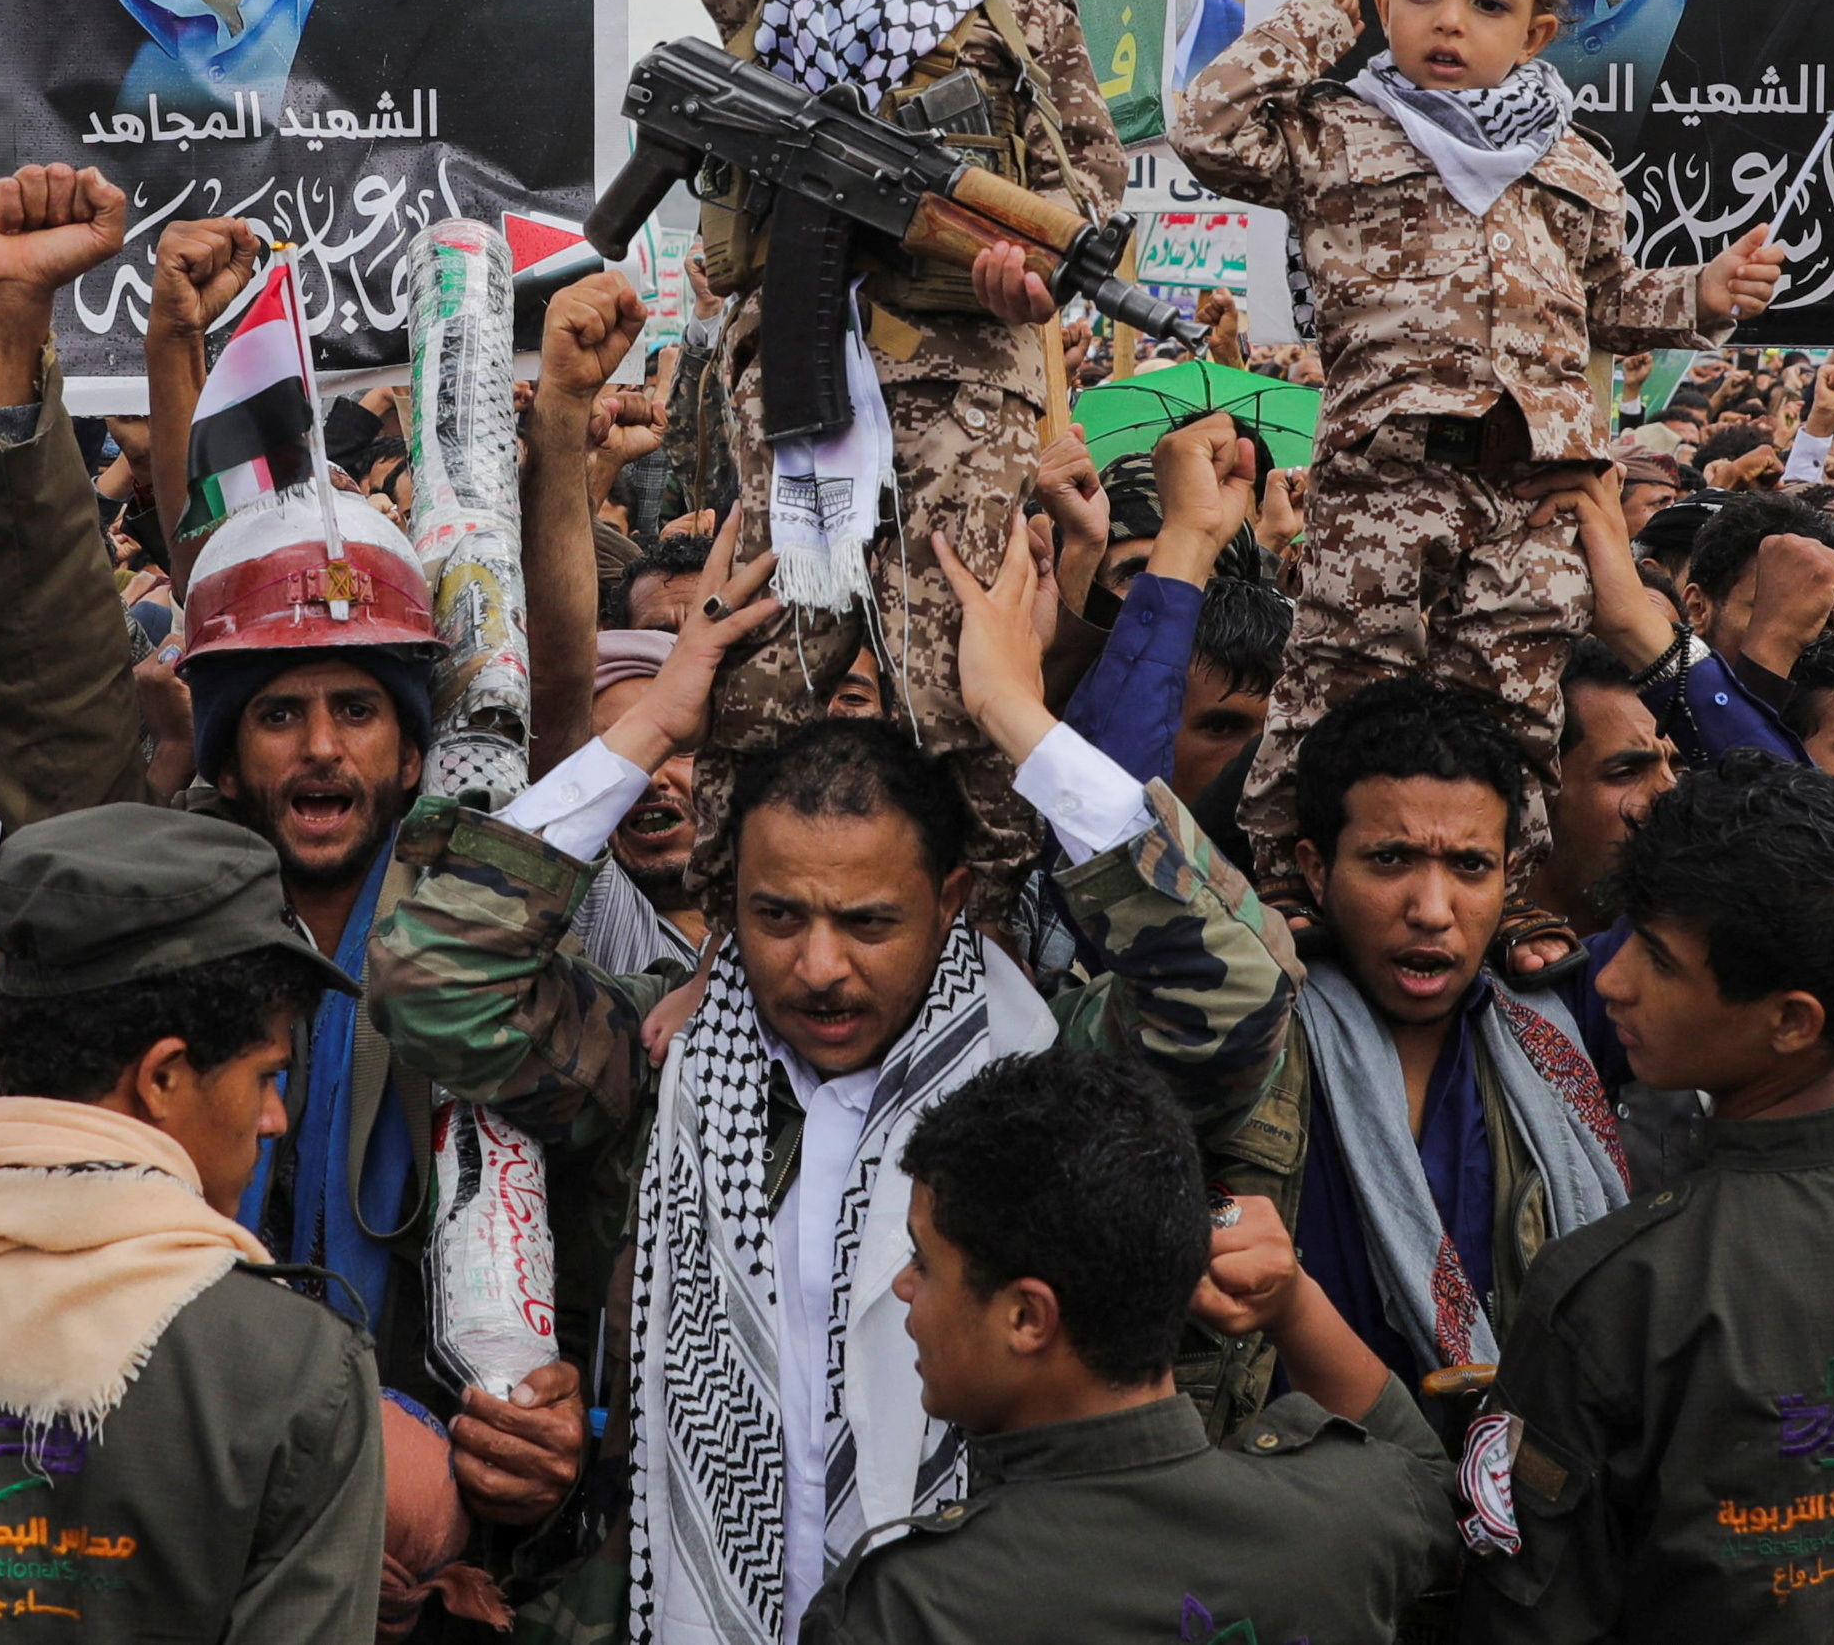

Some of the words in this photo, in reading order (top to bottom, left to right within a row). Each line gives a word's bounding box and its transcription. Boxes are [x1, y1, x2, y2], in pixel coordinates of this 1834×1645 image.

[82, 90, 262, 152] المجاهد
[280, 88, 438, 151] الشهيد
[1652, 63, 1826, 127] الشهيد
[1718, 1493, 1826, 1534] التربوية
